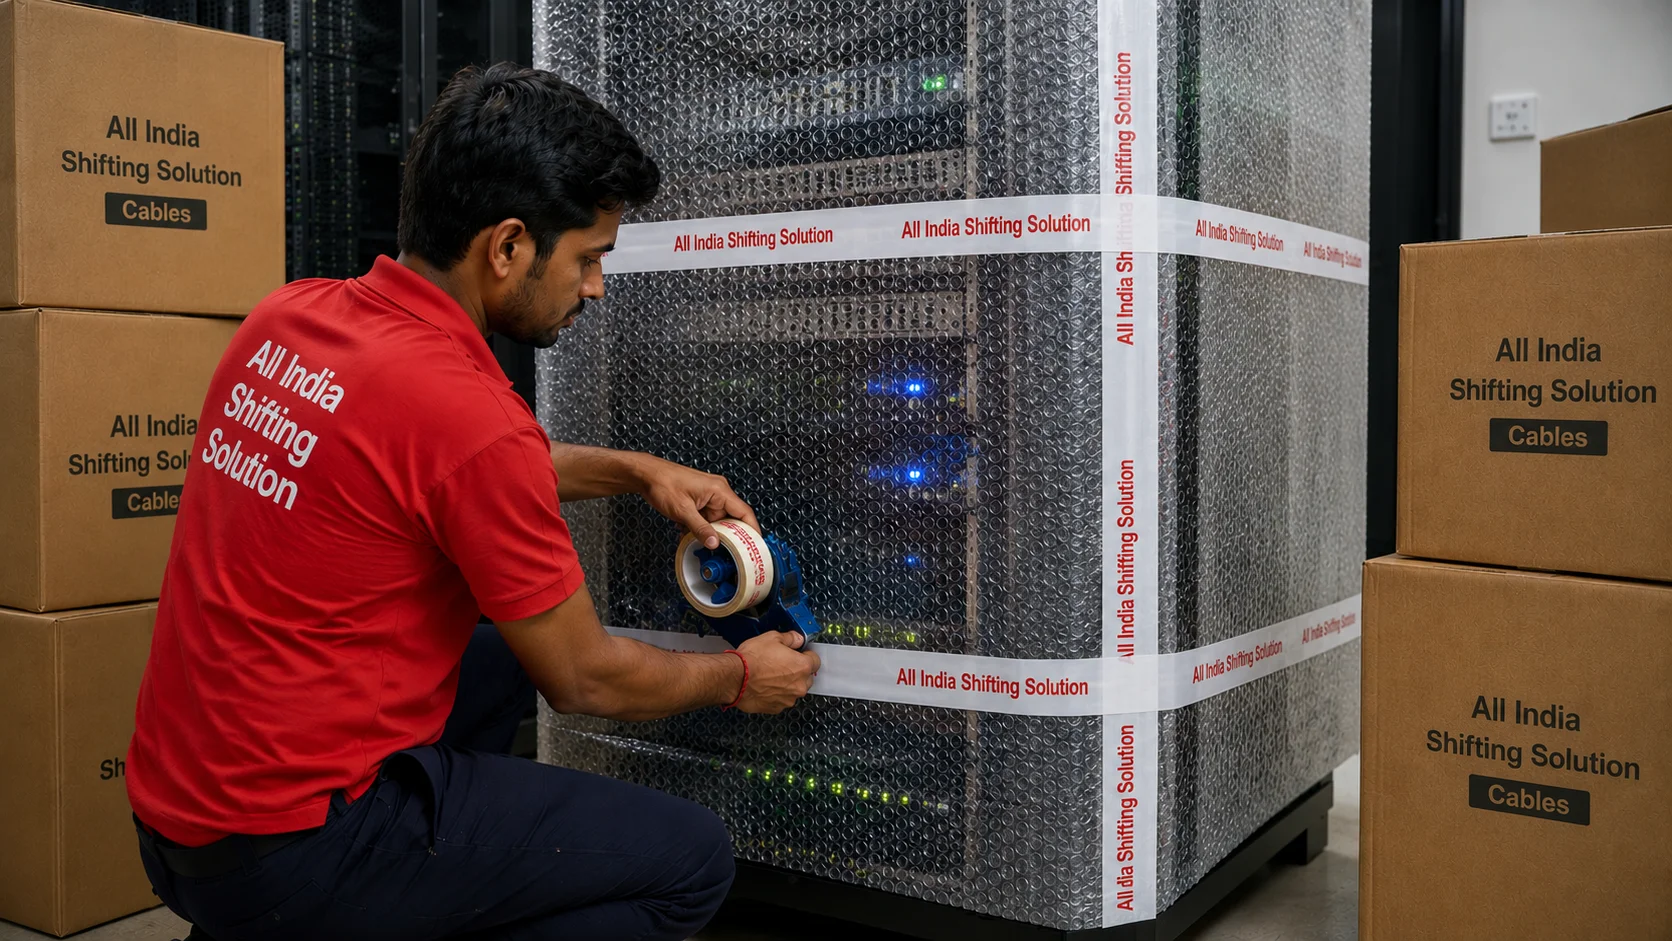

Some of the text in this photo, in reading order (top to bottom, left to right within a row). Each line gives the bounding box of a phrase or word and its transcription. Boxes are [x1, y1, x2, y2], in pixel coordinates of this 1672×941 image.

[107, 116, 199, 147] All India
[1114, 52, 1136, 195] Shifting Solution
[62, 150, 241, 186] Shifting Solution
[123, 200, 191, 222] Cables
[901, 213, 1090, 239] All India Shifting Solution
[674, 226, 833, 252] All India Shifting Solution
[1195, 219, 1284, 252] All India Shifting Solution
[1303, 241, 1311, 257] All
[1116, 277, 1134, 318] India
[1116, 323, 1134, 346] All
[1496, 337, 1601, 362] All India
[246, 340, 344, 413] All India
[1450, 378, 1656, 407] Shifting Solution
[110, 414, 198, 438] All India
[224, 383, 319, 468] Shifting
[1509, 426, 1587, 447] Cables
[69, 450, 191, 477] Shifting Sol
[203, 428, 297, 510] Solution
[127, 491, 179, 512] Cable
[1116, 459, 1139, 665] All India Shifting Solution
[1193, 640, 1283, 684] All India Shifting Solution
[896, 668, 1088, 700] All India Shifting Solution
[1471, 696, 1580, 731] All India
[1116, 725, 1134, 794] Solution
[1427, 730, 1640, 781] Shifting Solution
[1488, 784, 1570, 815] Cables
[1116, 797, 1138, 862] Shifting
[1117, 890, 1134, 911] All
